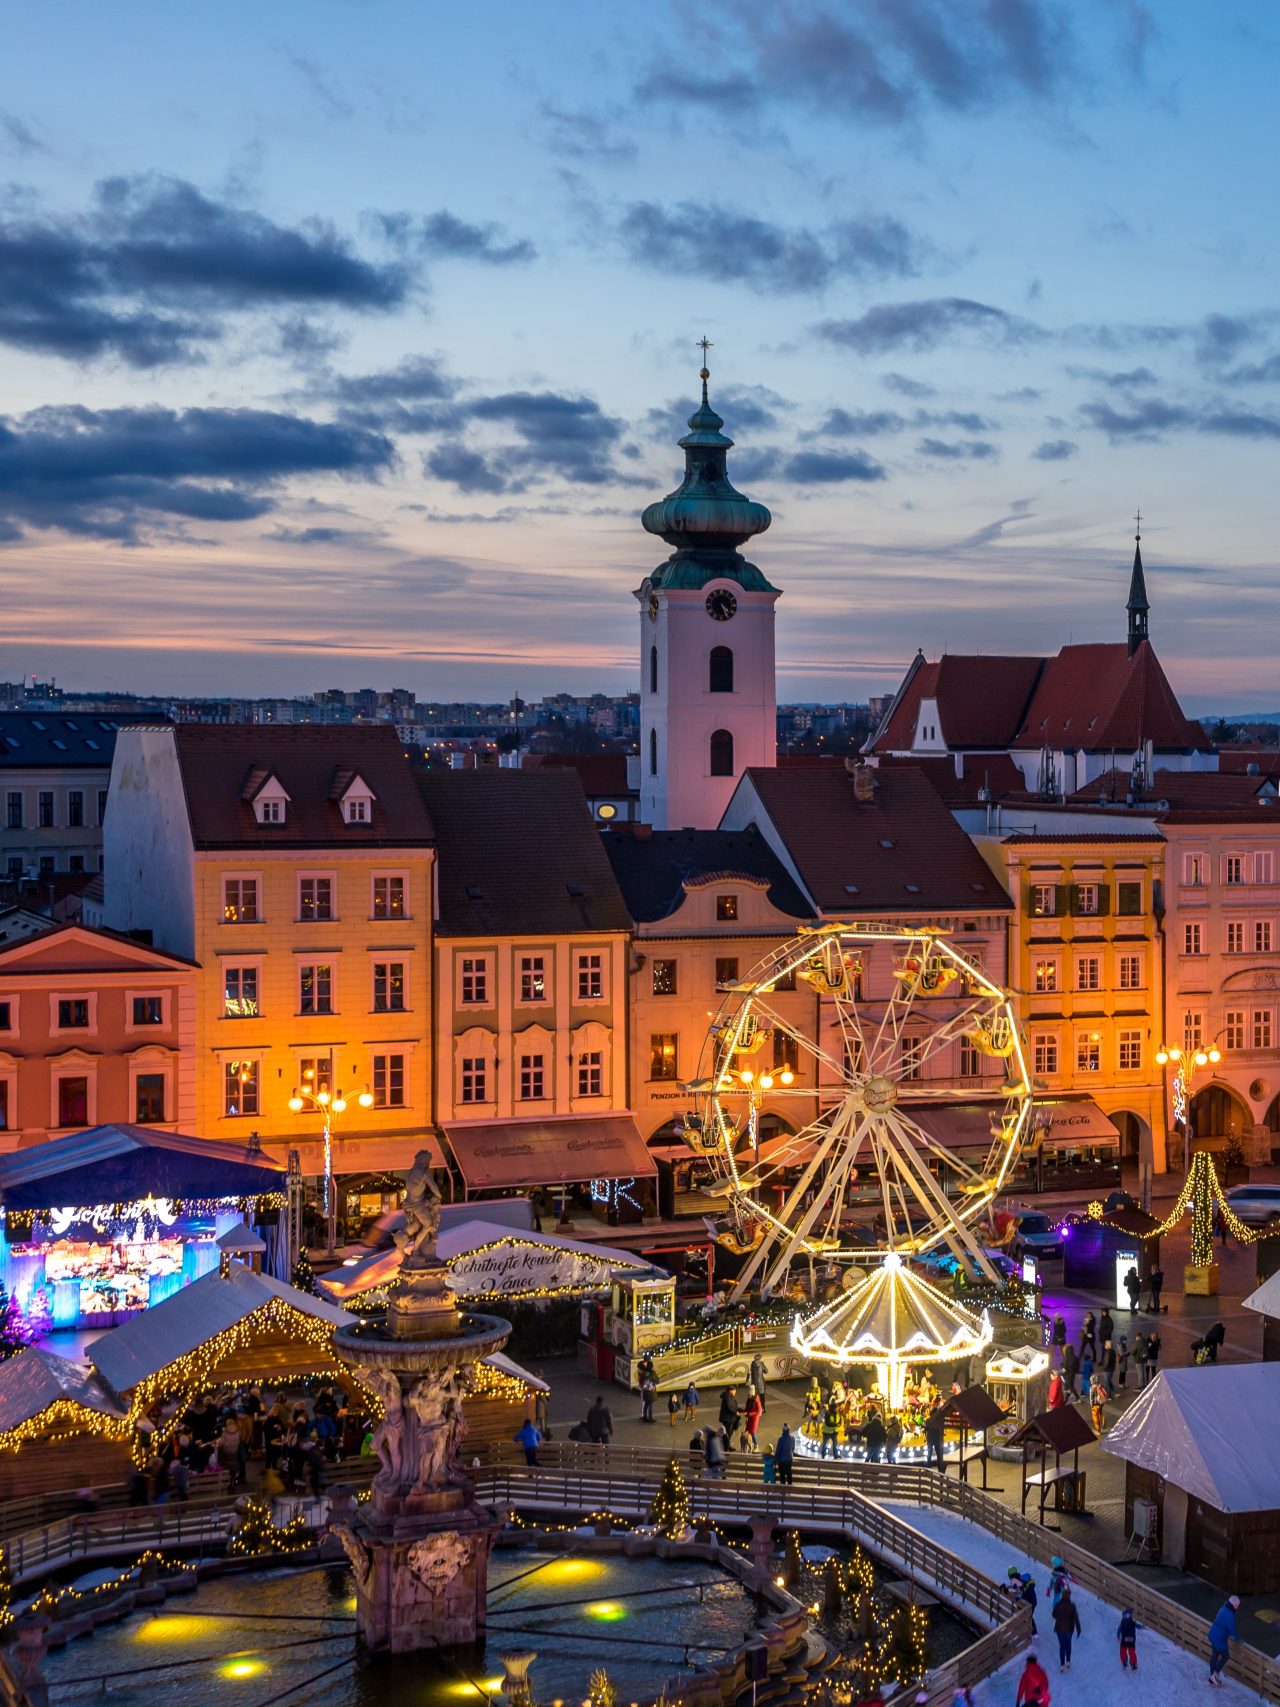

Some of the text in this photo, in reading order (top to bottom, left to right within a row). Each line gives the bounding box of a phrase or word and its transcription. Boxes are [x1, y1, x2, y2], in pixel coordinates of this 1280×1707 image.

[451, 1252, 563, 1277] Ochutnejte kouzlo
[481, 1275, 535, 1292] Vánoc
